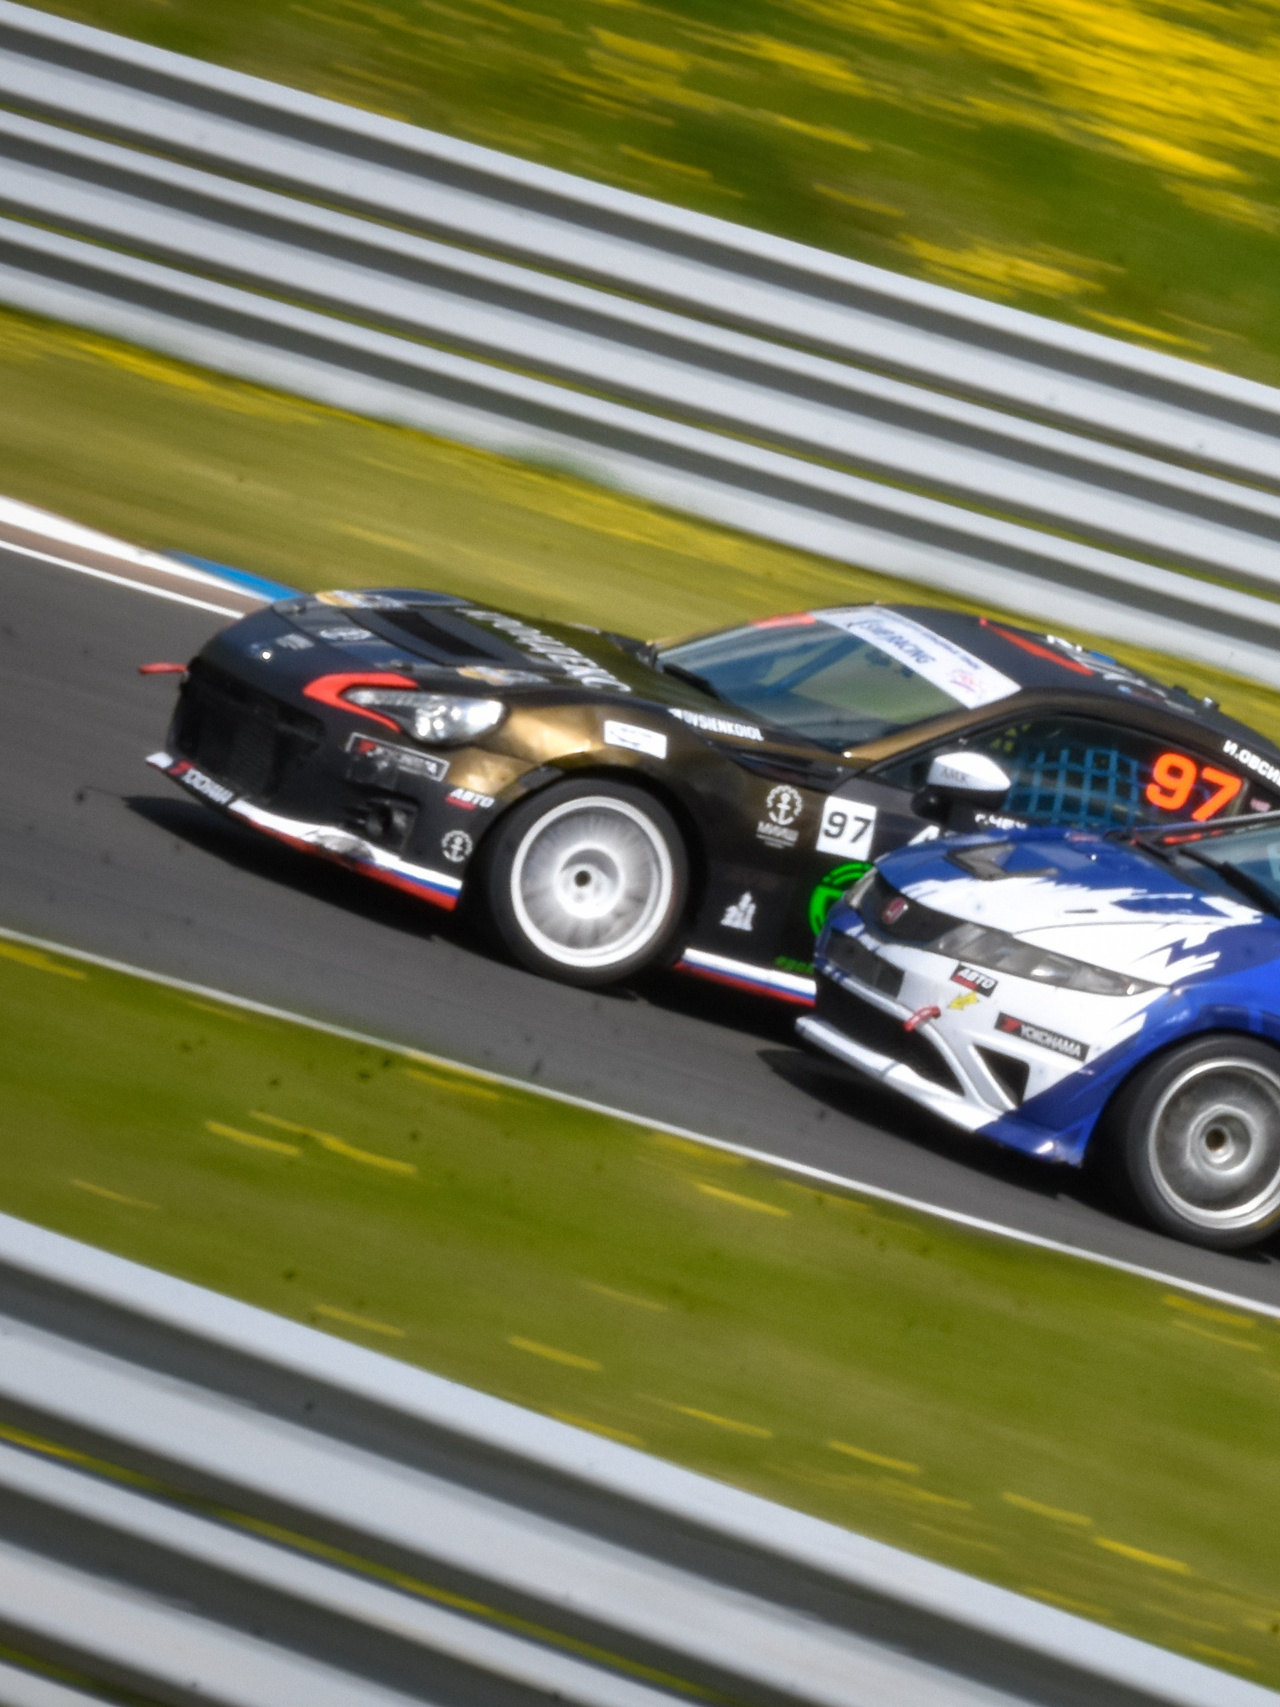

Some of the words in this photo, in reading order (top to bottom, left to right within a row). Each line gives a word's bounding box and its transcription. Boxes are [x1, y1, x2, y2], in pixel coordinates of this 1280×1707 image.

[1146, 752, 1243, 822] 97
[823, 810, 873, 844] 97
[1020, 1023, 1082, 1058] YOKOHAMA
